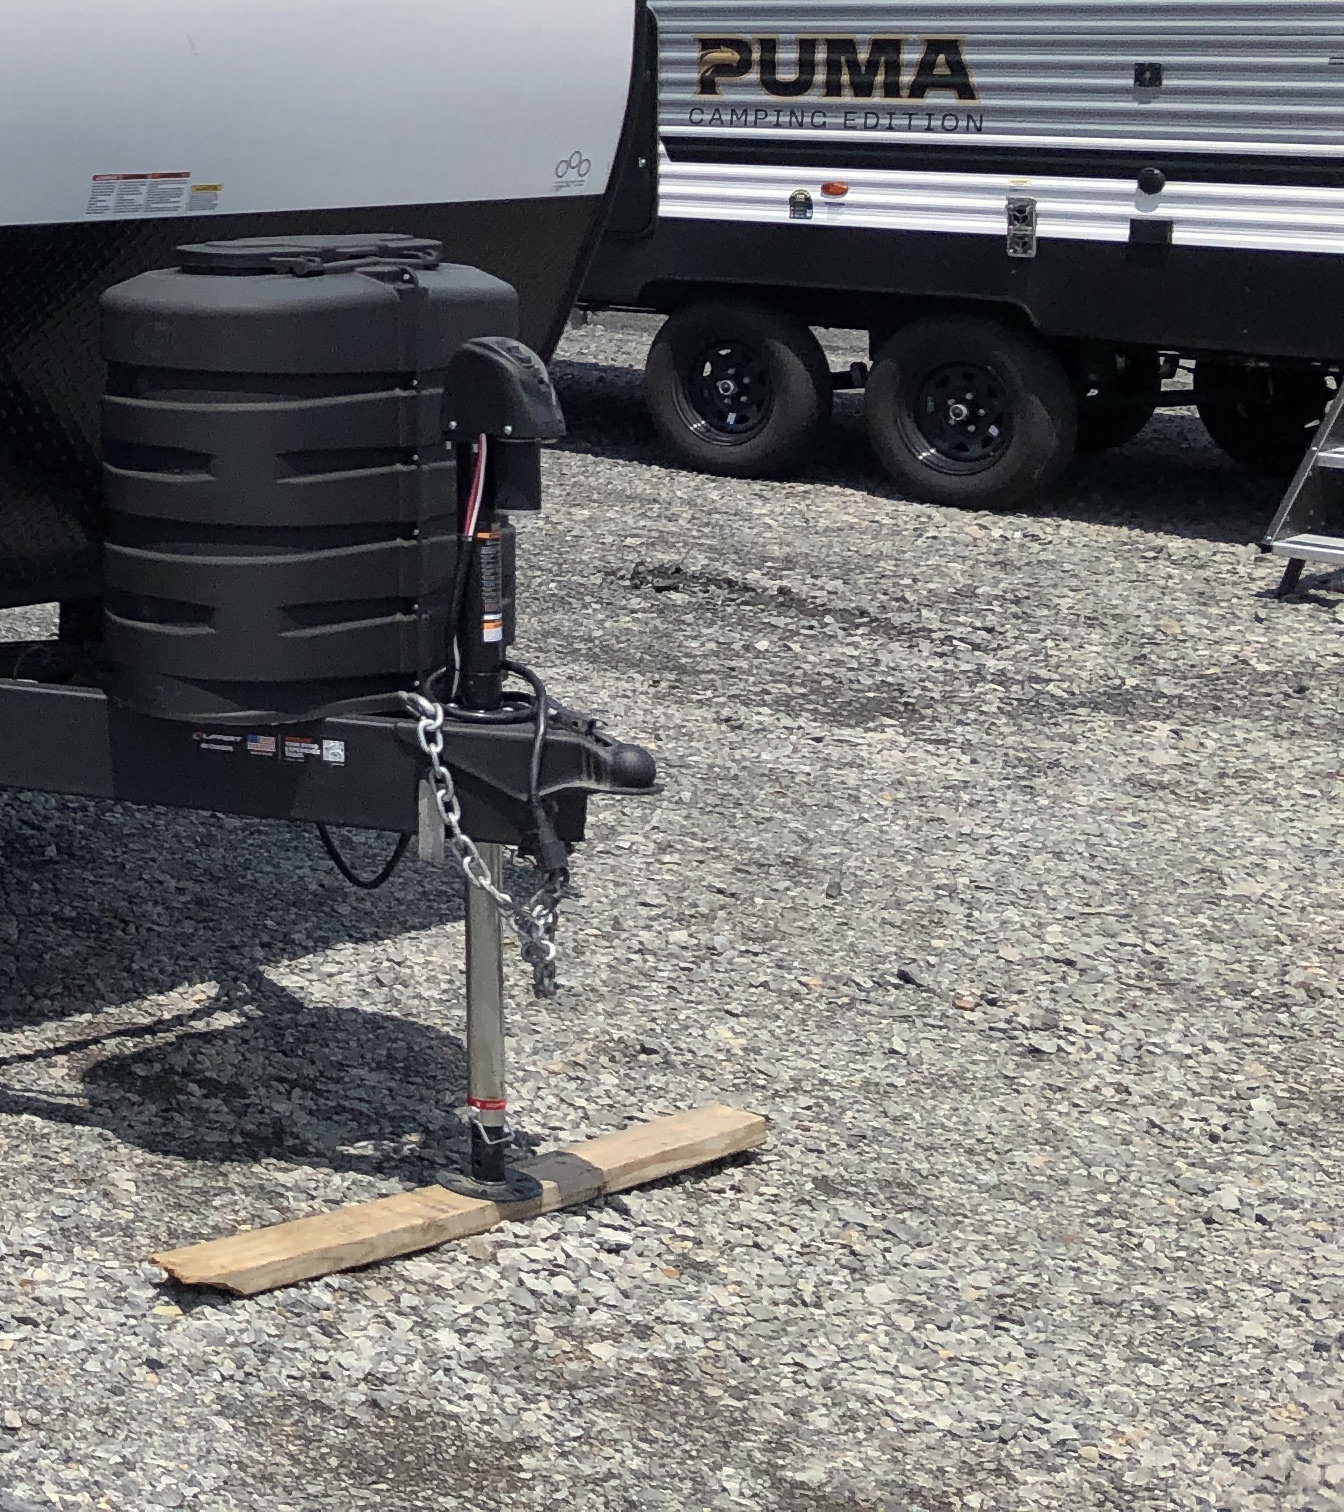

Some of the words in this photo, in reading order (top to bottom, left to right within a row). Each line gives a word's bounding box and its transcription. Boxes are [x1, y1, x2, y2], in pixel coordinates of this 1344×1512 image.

[691, 33, 981, 104] PUMA
[688, 106, 828, 129] CAMPING
[843, 110, 985, 133] EDITION
